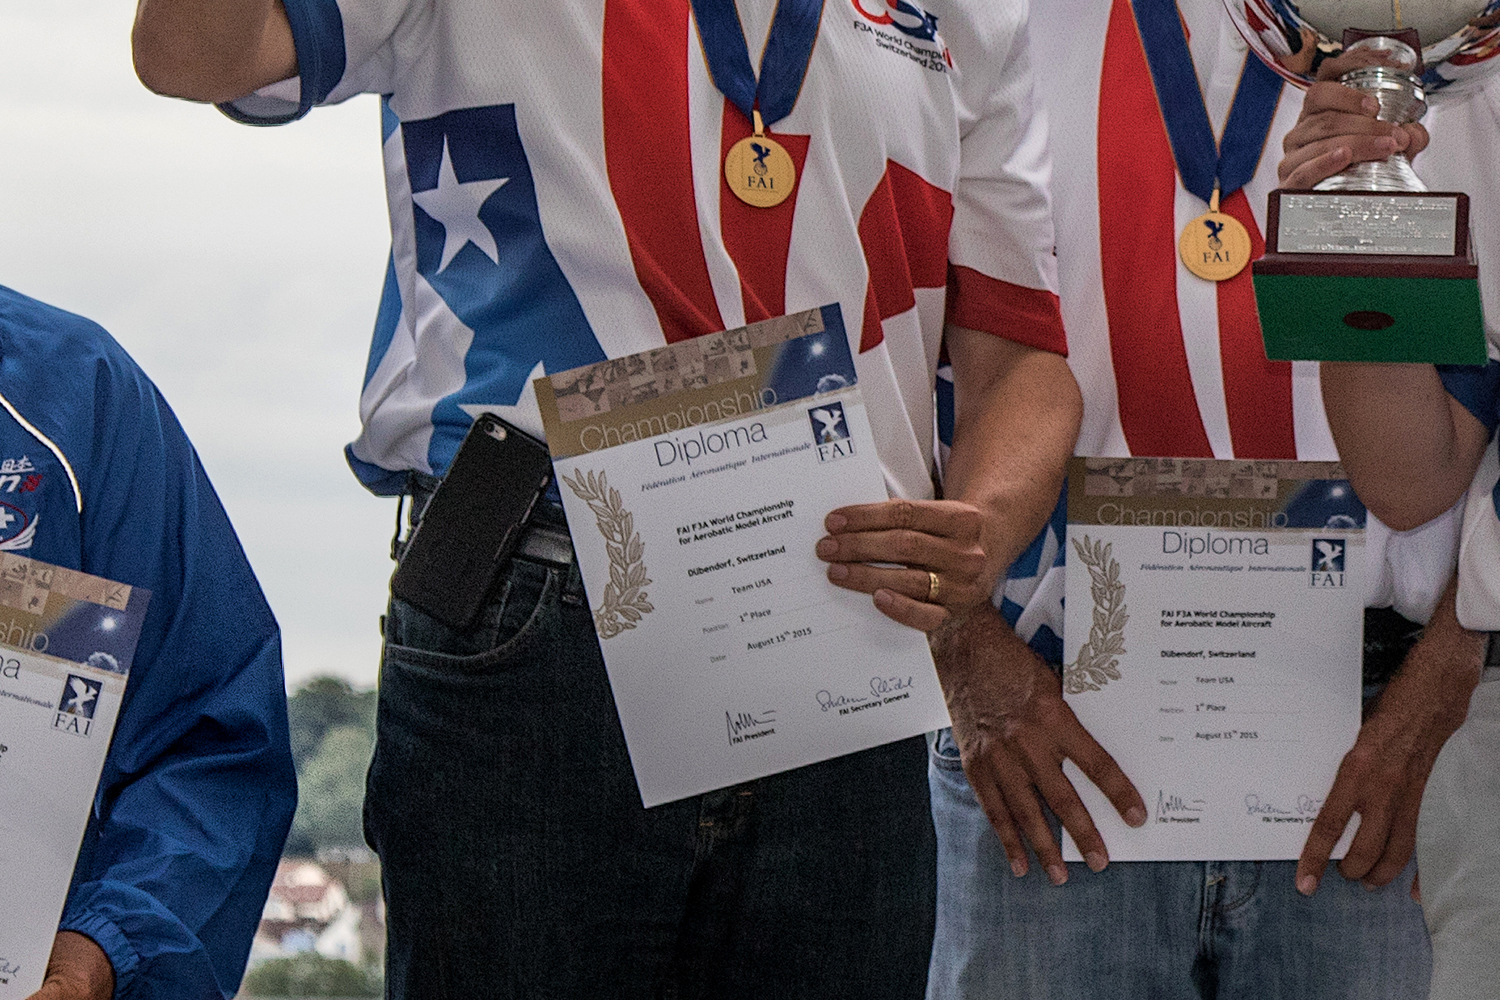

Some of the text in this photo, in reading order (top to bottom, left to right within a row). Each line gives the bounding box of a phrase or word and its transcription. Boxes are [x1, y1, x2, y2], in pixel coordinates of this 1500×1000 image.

[854, 21, 902, 46] F3A World
[876, 39, 927, 68] Switzerland
[929, 61, 947, 73] 201
[748, 176, 773, 189] FAI
[1203, 251, 1229, 263] FAI
[580, 386, 778, 452] Championship
[653, 422, 768, 467] Diploma
[817, 439, 854, 462] FAI
[677, 500, 794, 535] FAI F3A World Championship
[1097, 503, 1289, 528] Championship
[679, 510, 793, 546] for Aerobatic Model Aircraft
[1162, 531, 1269, 559] Diploma
[688, 546, 786, 577] Dübendorf, Switzerland
[732, 578, 772, 594] Team USA
[1311, 573, 1345, 586] FAI
[751, 609, 771, 619] Place
[1160, 620, 1172, 628] for
[1215, 620, 1239, 628] Model
[1241, 620, 1272, 628] Aircraft
[1161, 610, 1174, 618] FAI
[1193, 610, 1217, 618] World
[1219, 610, 1275, 619] Championship
[747, 638, 774, 651] August
[792, 627, 812, 638] 2015
[1208, 650, 1256, 658] Switzerland
[851, 700, 882, 713] Secretary
[883, 692, 909, 704] General
[54, 714, 91, 735] FAI
[744, 728, 775, 742] President
[1195, 732, 1221, 740] August
